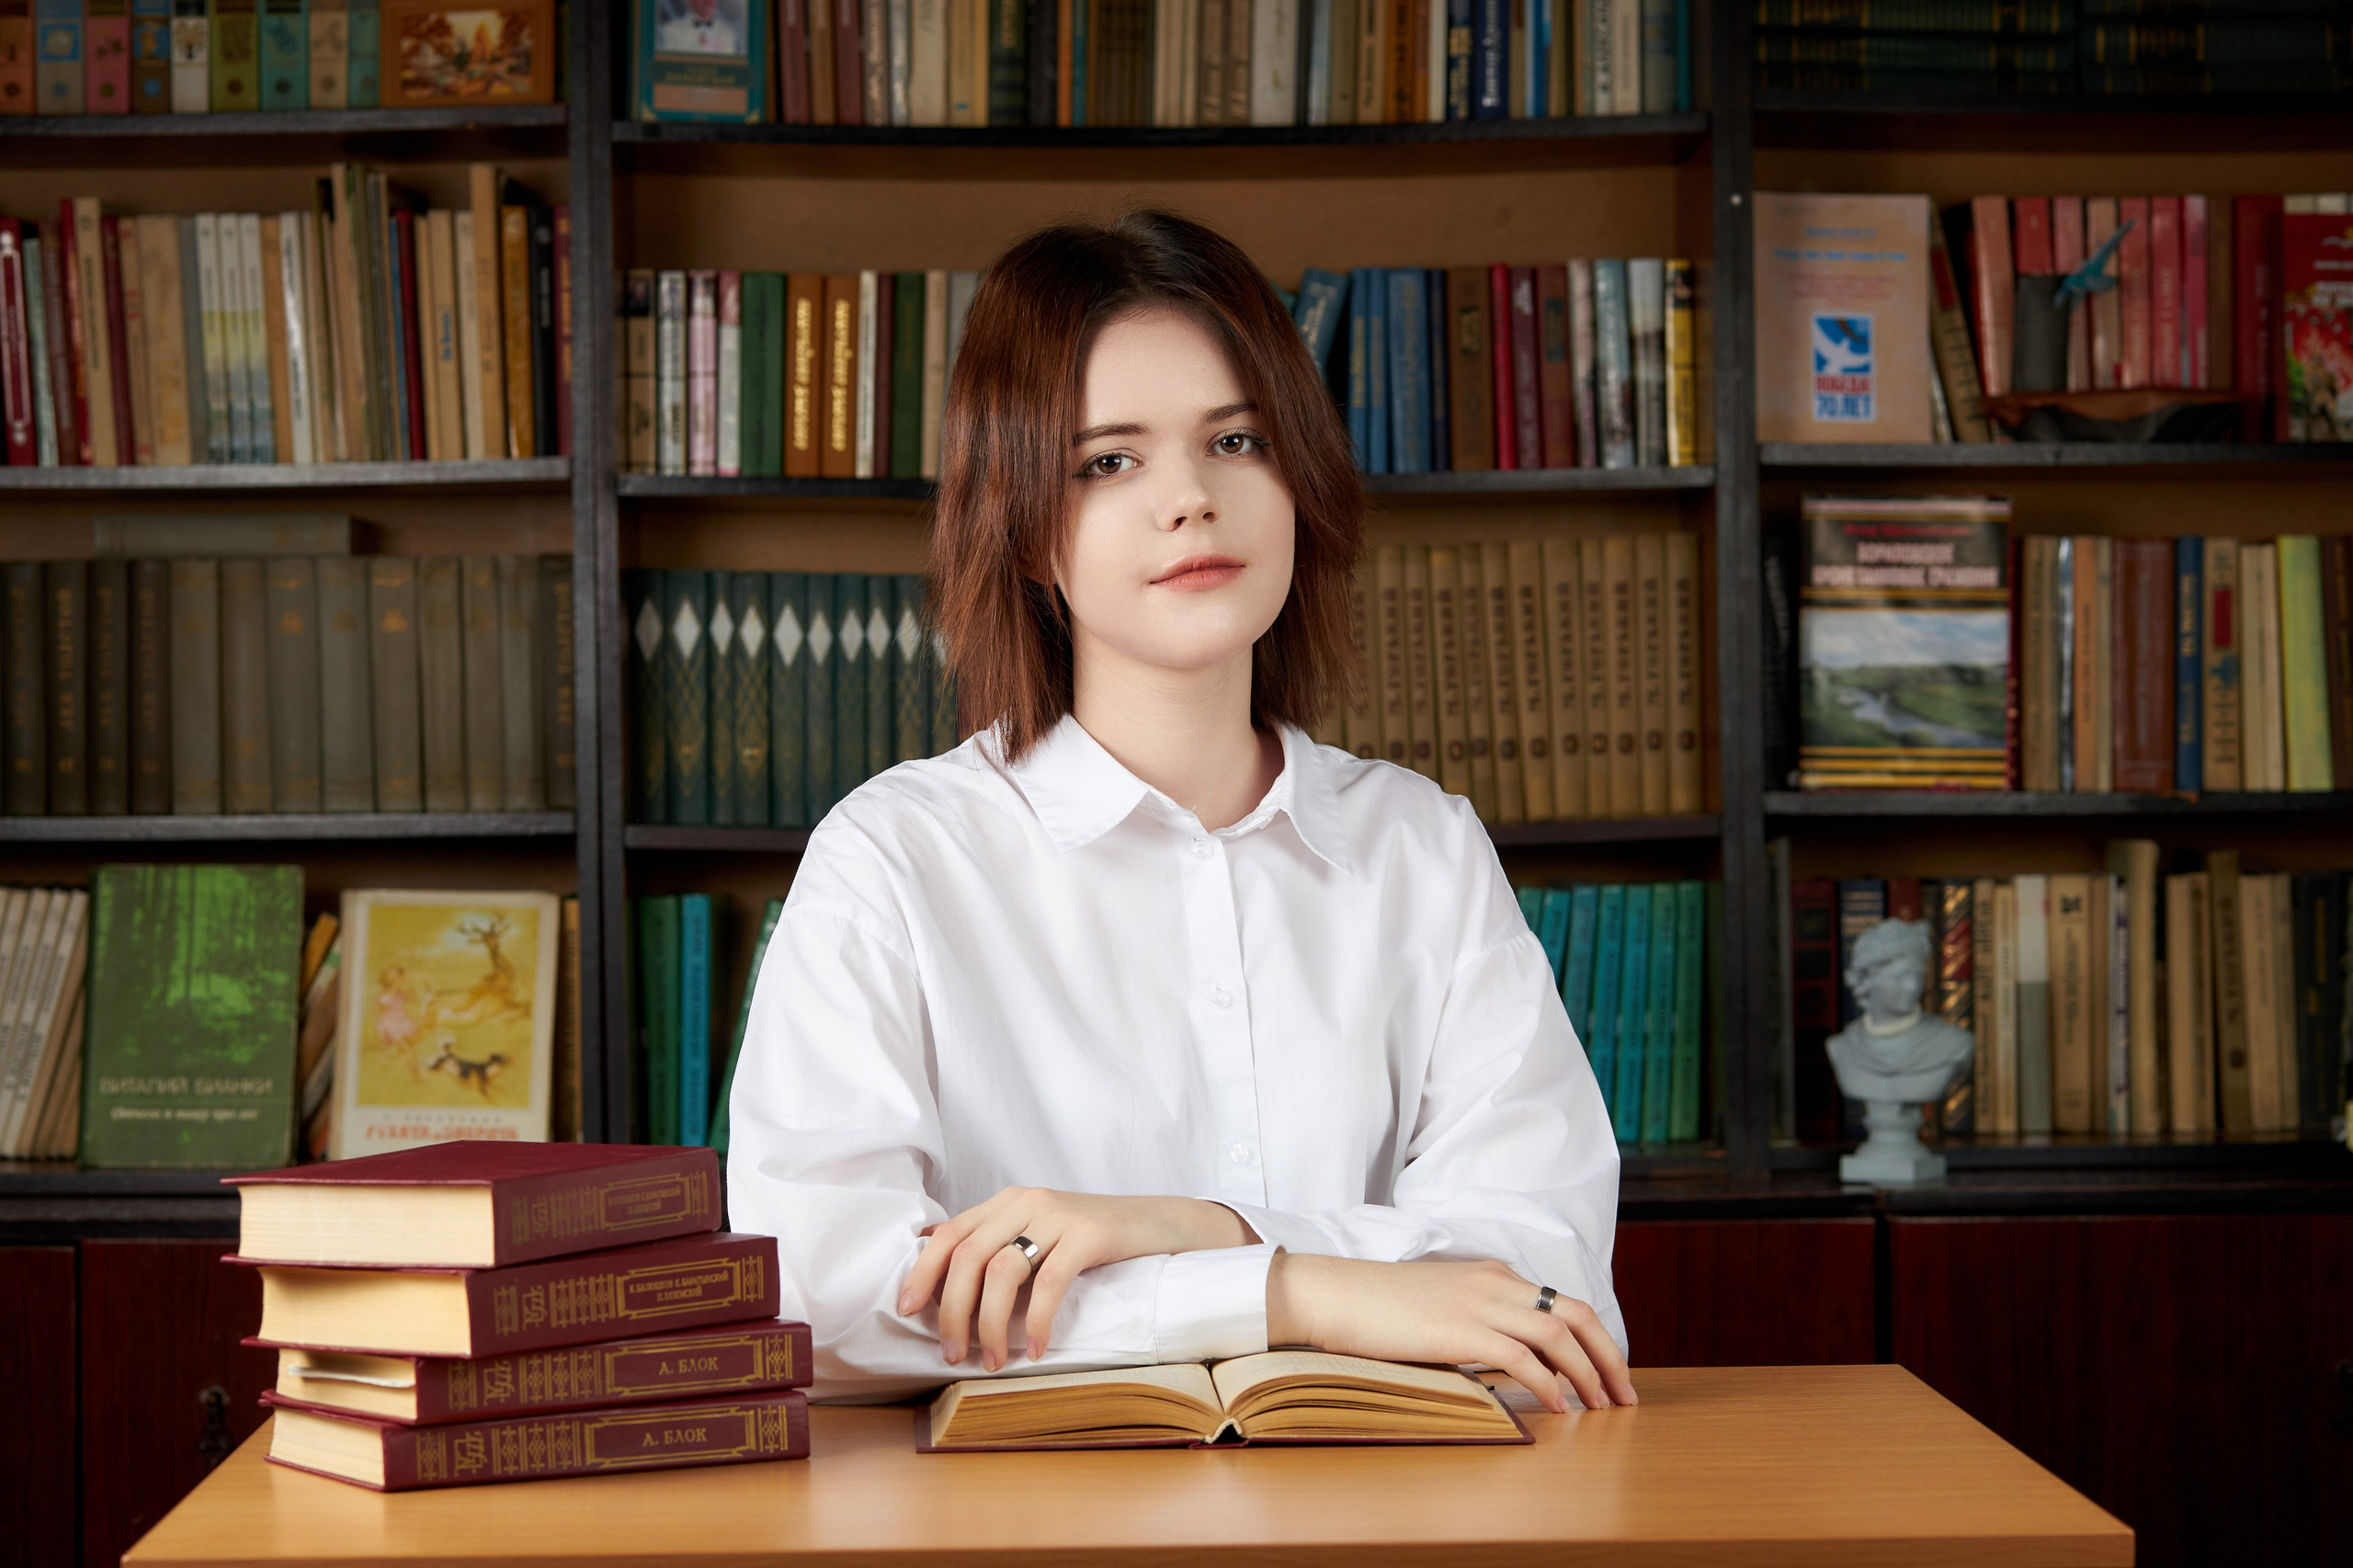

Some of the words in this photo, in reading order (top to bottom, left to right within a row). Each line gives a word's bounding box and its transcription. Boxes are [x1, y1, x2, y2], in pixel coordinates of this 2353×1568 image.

[659, 1361, 673, 1375] А.
[678, 1357, 719, 1373] БЛОК
[642, 1432, 659, 1446] А.
[664, 1427, 707, 1445] БЛОК
